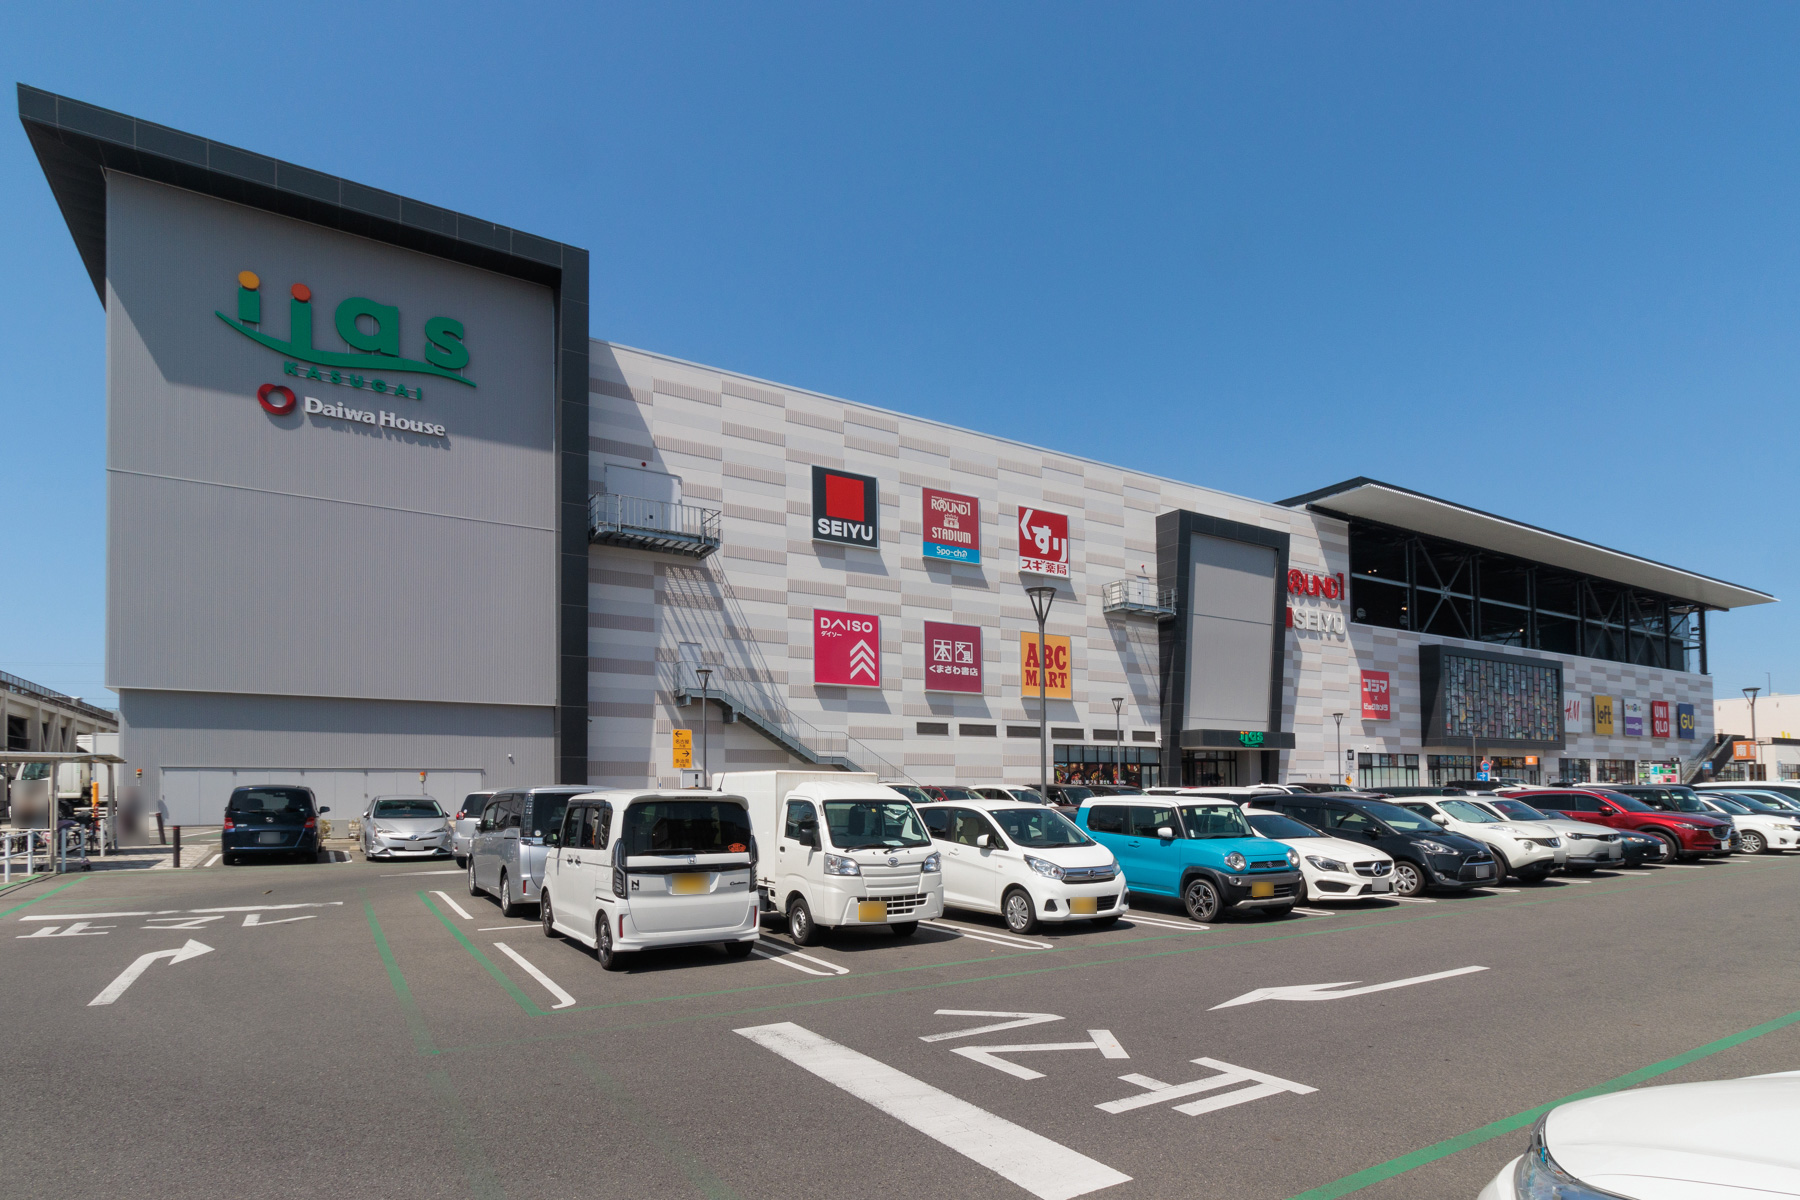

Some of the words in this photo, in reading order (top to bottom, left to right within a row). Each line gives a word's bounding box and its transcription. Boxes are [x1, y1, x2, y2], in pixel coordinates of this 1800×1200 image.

[237, 270, 470, 370] iias
[284, 361, 422, 400] KASUGAI
[304, 396, 376, 425] Daiwa
[379, 410, 446, 437] House
[817, 517, 874, 541] SEIYU
[931, 526, 971, 544] STADIUM
[1020, 508, 1067, 563] くすり
[1021, 559, 1067, 576] スギ薬局
[820, 617, 873, 633] DAISO
[1292, 608, 1346, 635] SEIYU
[1025, 642, 1067, 671] ABC
[929, 664, 979, 677] くまざわ書店
[1363, 678, 1388, 693] コジマ
[1654, 705, 1667, 719] UNI
[1655, 720, 1668, 735] QLO
[1681, 713, 1694, 730] GU
